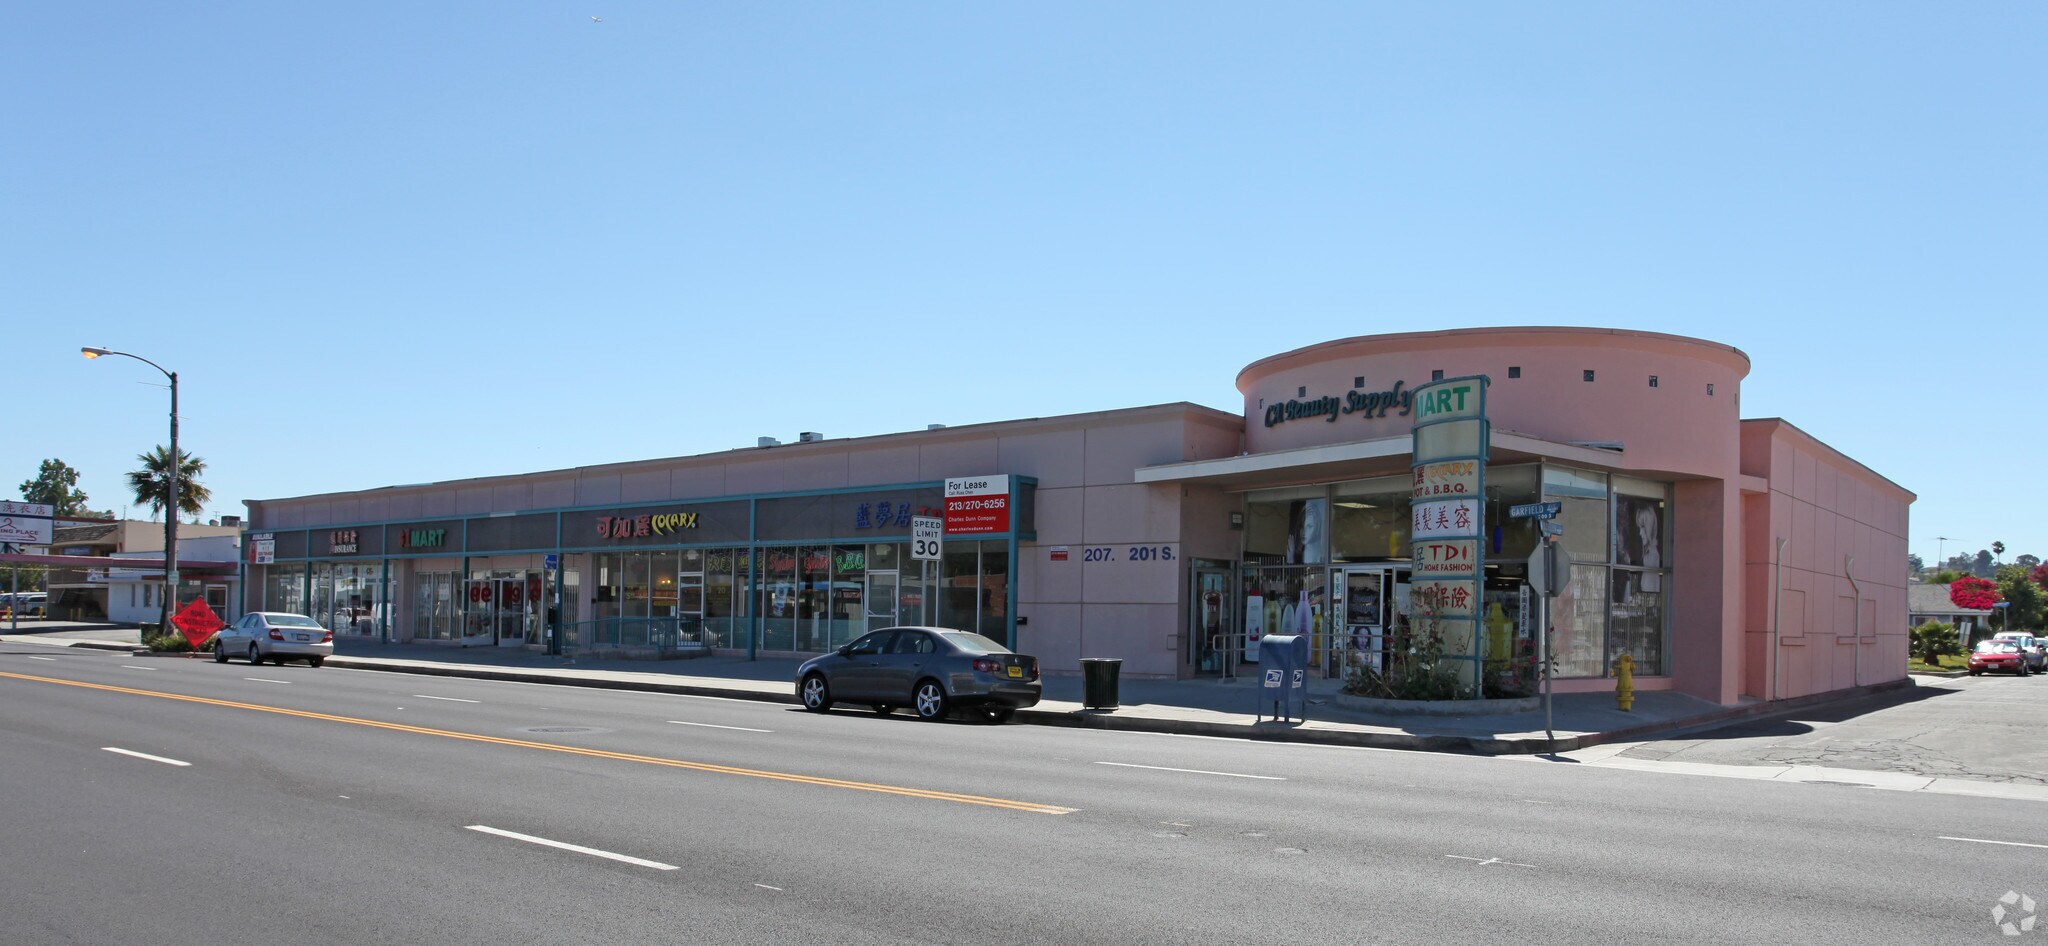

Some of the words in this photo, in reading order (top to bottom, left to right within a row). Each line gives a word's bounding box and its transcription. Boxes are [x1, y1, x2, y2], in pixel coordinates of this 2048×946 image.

[1285, 395, 1340, 423] Beauty
[1343, 380, 1412, 418] Supply
[948, 481, 961, 490] For
[964, 481, 988, 490] Lease
[1425, 487, 1431, 496] &
[1434, 483, 1468, 494] B.B.Q.
[949, 499, 1005, 511] 213/270-6256
[1511, 505, 1544, 517] GARFIELD
[651, 512, 696, 536] COCARY
[914, 520, 941, 528] SPEED
[411, 529, 445, 547] MART
[334, 544, 357, 553] INSURANCE
[915, 540, 939, 556] 30
[1084, 548, 1115, 561] 207.
[1129, 547, 1157, 560] 201
[1161, 546, 1176, 561] S.
[1428, 544, 1468, 561] TDI
[1441, 563, 1473, 571] FASHION
